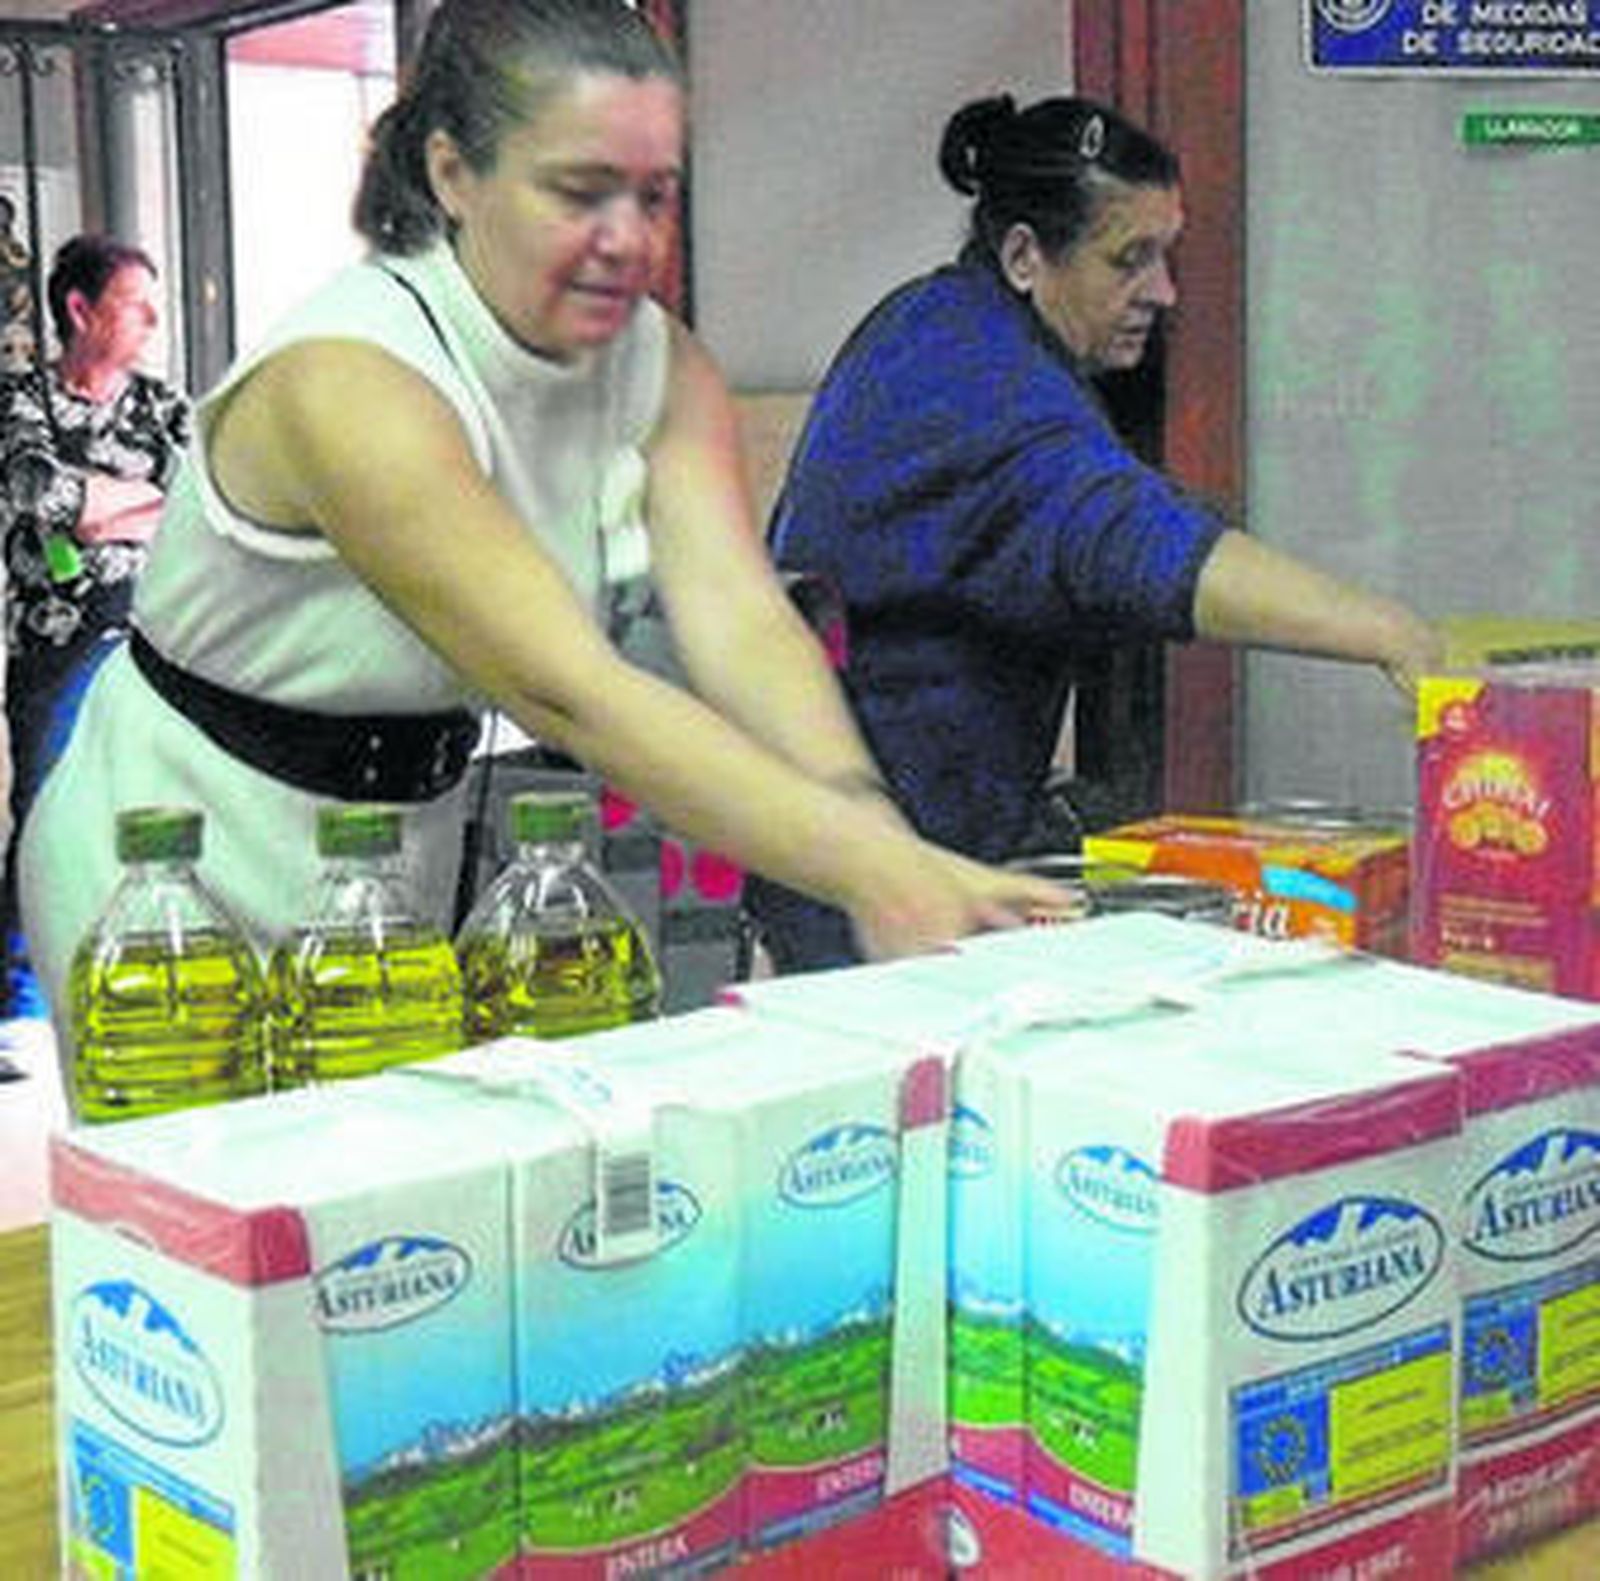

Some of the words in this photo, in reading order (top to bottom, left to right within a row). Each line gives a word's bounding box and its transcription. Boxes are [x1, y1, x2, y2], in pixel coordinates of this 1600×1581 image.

[1422, 2, 1458, 25] DE
[1470, 1, 1588, 25] MEDIDAS
[1402, 31, 1438, 54] DE
[1256, 1244, 1426, 1318] ASTURIANA
